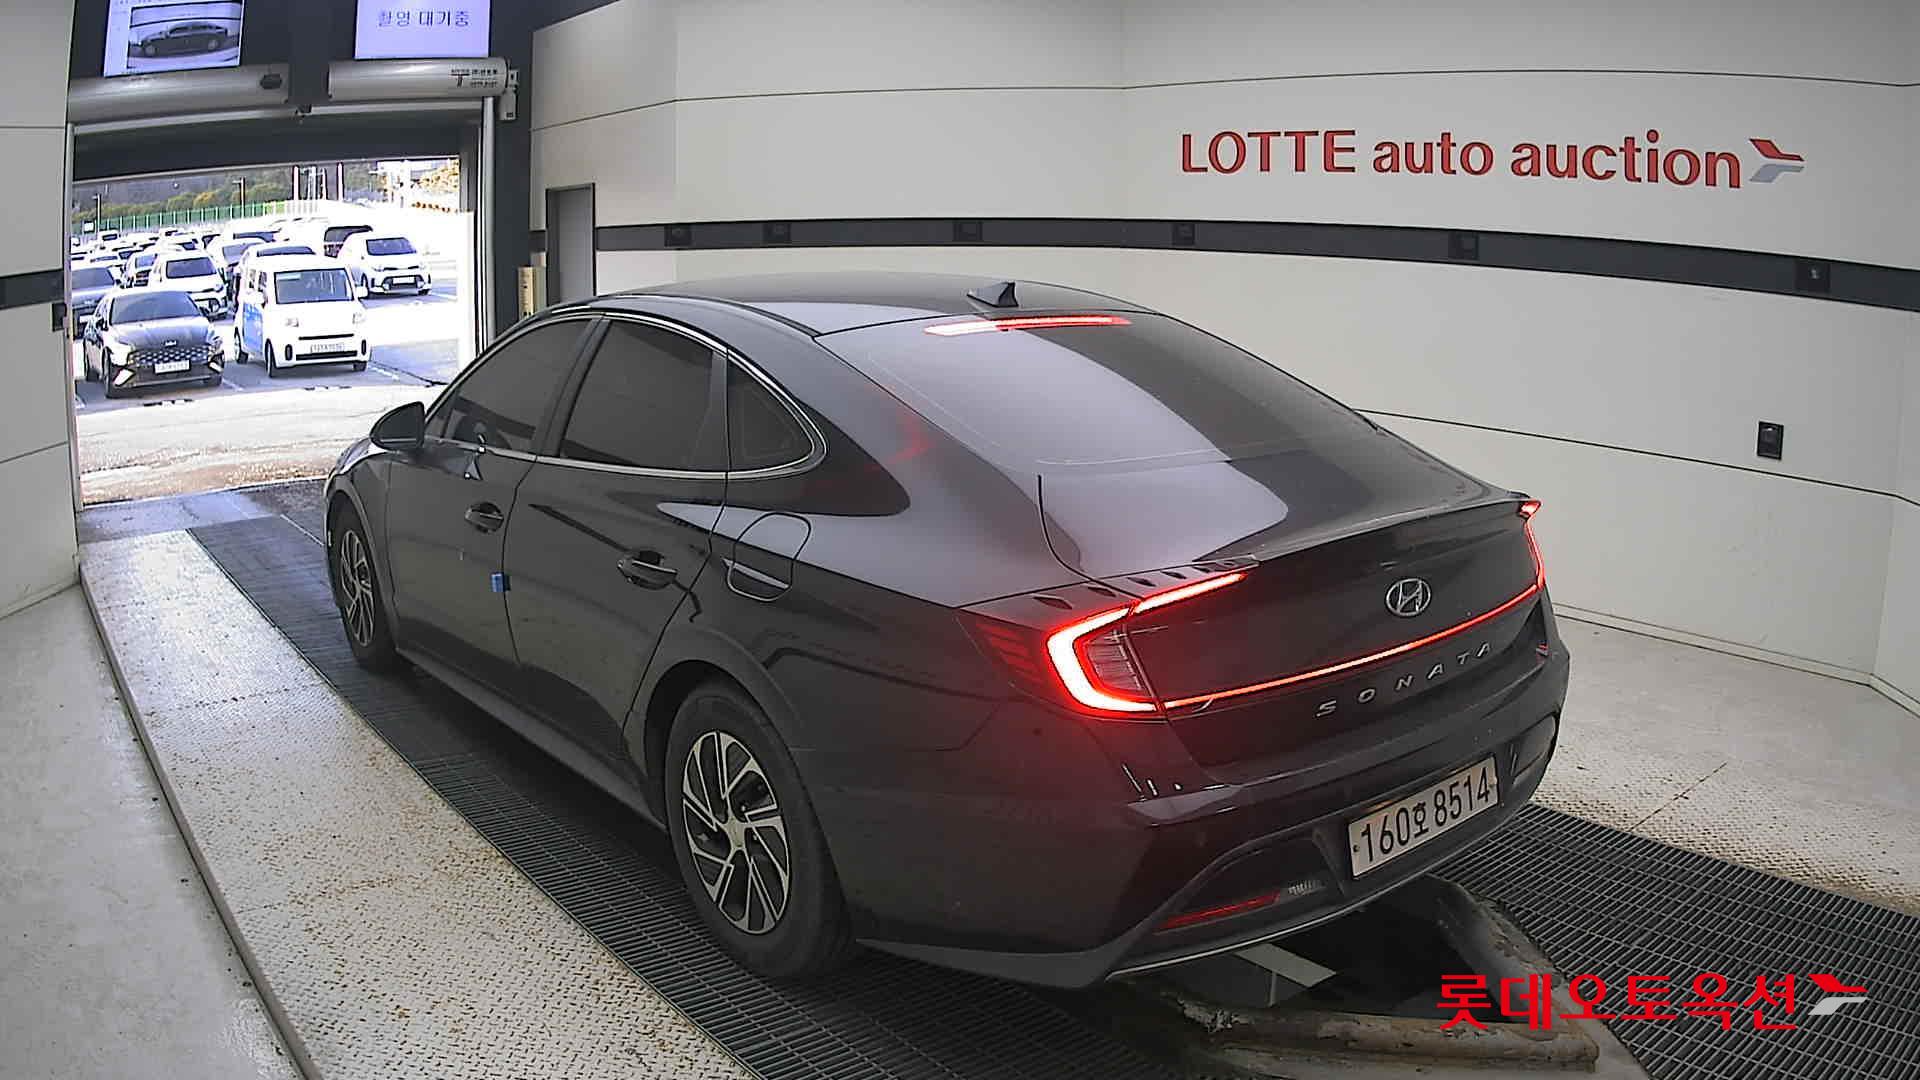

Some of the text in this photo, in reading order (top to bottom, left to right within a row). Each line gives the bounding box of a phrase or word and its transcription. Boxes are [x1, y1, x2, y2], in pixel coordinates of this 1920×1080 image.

[420, 10, 469, 27] 대기중
[1181, 129, 1741, 188] LOTTE auto auction
[1315, 642, 1492, 717] SONATA
